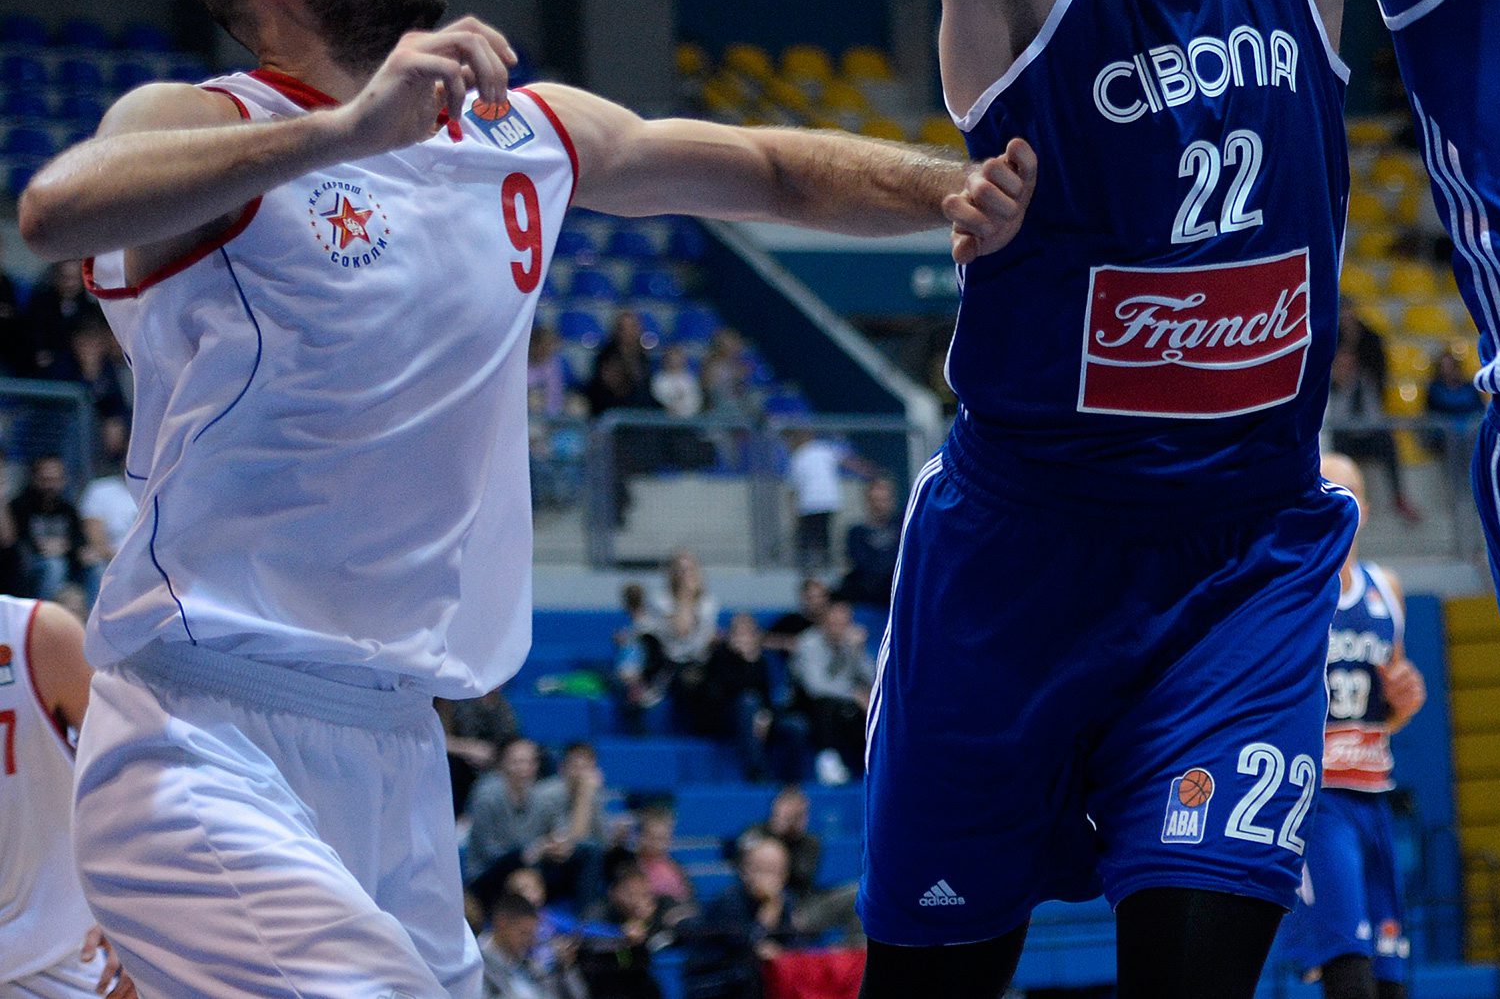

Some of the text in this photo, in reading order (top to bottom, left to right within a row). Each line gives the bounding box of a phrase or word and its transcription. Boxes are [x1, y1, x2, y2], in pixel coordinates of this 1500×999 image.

[1093, 25, 1299, 123] CIBONA
[490, 115, 531, 149] ABA
[1171, 129, 1263, 244] 22
[330, 237, 388, 268] СОКОЛИ
[501, 172, 541, 294] 9
[1095, 281, 1310, 348] Franck
[1166, 810, 1199, 836] ABA
[1224, 742, 1316, 856] 22
[919, 896, 966, 907] adidas
